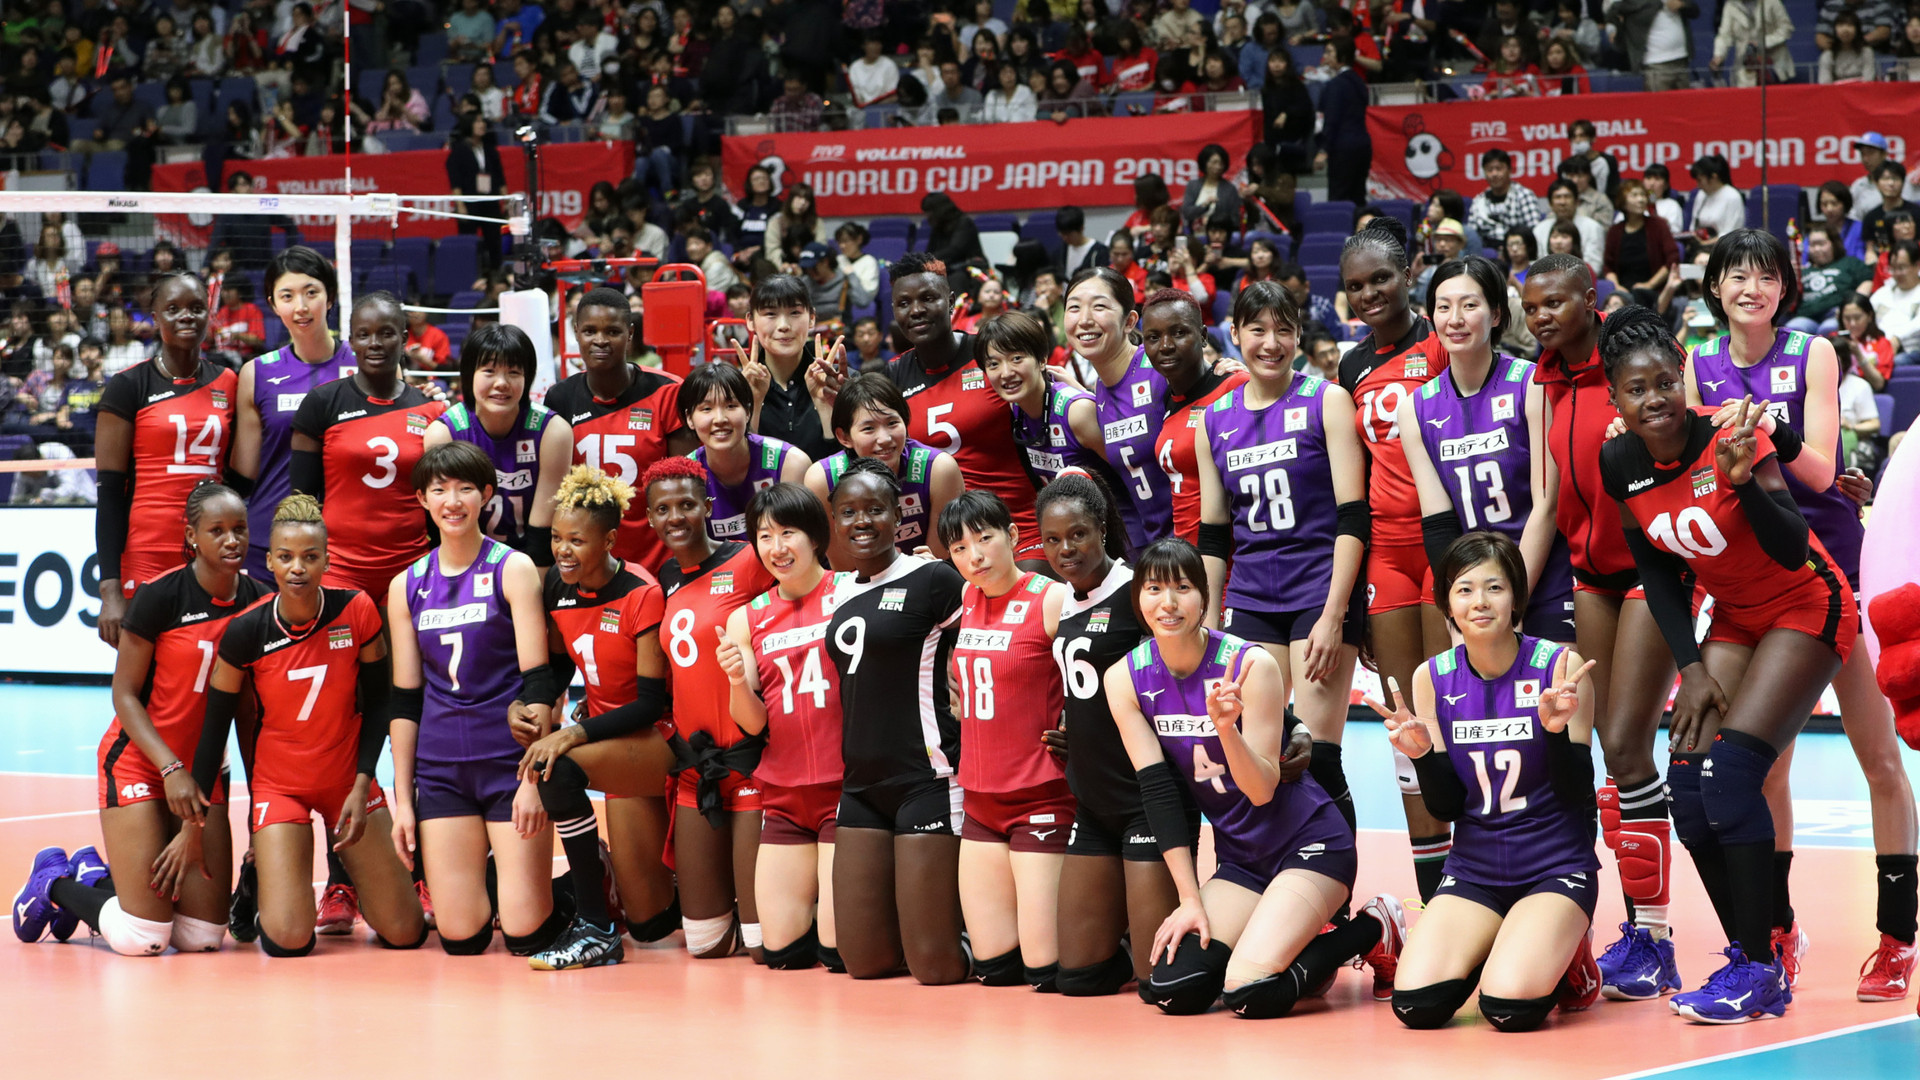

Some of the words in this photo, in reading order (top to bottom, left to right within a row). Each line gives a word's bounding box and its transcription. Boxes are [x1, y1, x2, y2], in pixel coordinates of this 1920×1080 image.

[1521, 118, 1648, 141] VOLLBALL
[855, 145, 967, 162] VOLLEYBALL
[1464, 147, 1562, 181] WORL
[1604, 142, 1680, 174] CUP
[1815, 135, 1906, 165] 209
[803, 168, 918, 197] WORLD
[925, 165, 993, 193] CUP
[996, 159, 1104, 190] JAPAN
[1113, 158, 1200, 185] 2019
[108, 197, 139, 208] MIKASA
[962, 380, 985, 391] KEN
[1404, 367, 1428, 378] KEN
[903, 383, 926, 398] MIKASA
[1776, 384, 1793, 392] JPN
[338, 409, 368, 421] MIKASA
[628, 420, 651, 431] KEN
[1185, 419, 1198, 428] KE
[1363, 382, 1407, 443] 19
[168, 414, 223, 466] 14
[927, 402, 962, 455] 5
[1105, 417, 1146, 440] 日産デイズ
[1228, 441, 1295, 469] 日産デイズ
[1442, 431, 1506, 457] 日産デイズ
[361, 436, 399, 489] 3
[576, 434, 638, 486] 15
[1119, 445, 1153, 500] 5
[1158, 439, 1184, 494] 4
[1240, 468, 1296, 532] 28
[1454, 460, 1512, 530] 13
[1693, 481, 1718, 499] KEN
[1647, 506, 1728, 559] 10
[710, 584, 734, 595] KEN
[181, 611, 209, 623] MIKASA
[877, 601, 904, 612] KEN
[600, 621, 619, 634] KEN
[669, 608, 698, 668] 8
[1085, 622, 1109, 633] KEN
[264, 637, 292, 653] MIKASA
[329, 637, 353, 650] KEN
[834, 615, 866, 675] 9
[440, 632, 464, 691] 7
[572, 633, 600, 686] 1
[1052, 636, 1099, 700] 16
[287, 664, 328, 721] 7
[773, 646, 830, 715] 14
[957, 656, 995, 720] 18
[1453, 720, 1531, 740] 日産デイズ
[1193, 744, 1228, 794] 4
[1468, 749, 1527, 815] 12
[738, 787, 760, 797] MIKA
[255, 802, 270, 825] 7
[1130, 834, 1157, 844] MIKAS
